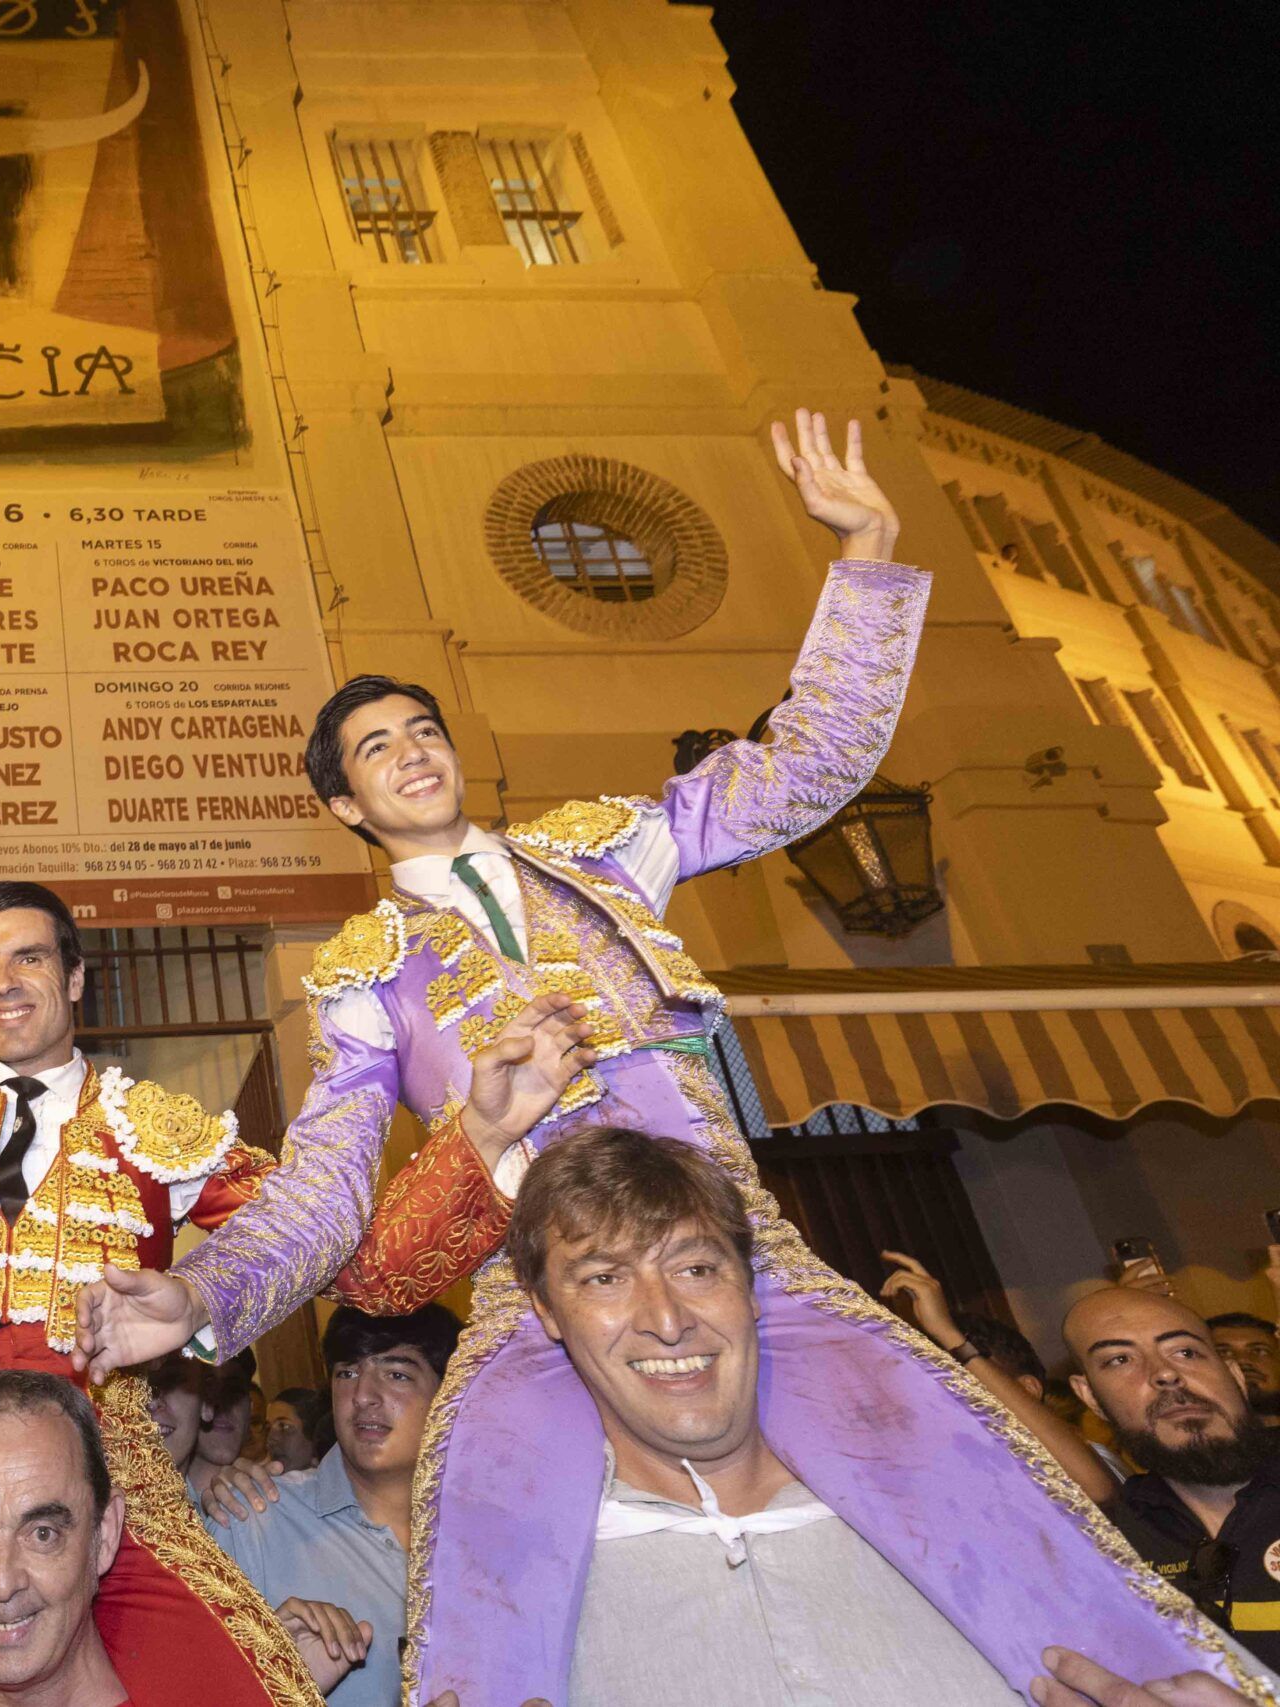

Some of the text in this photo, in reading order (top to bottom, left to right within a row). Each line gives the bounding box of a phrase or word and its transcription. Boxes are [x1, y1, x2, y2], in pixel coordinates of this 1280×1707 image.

[69, 507, 207, 525] 6,30 TARDE
[2, 542, 38, 550] CORRIDA
[81, 539, 162, 550] MARTES 15
[223, 541, 258, 549] CORRIDA
[93, 557, 253, 567] 6 TOROS de VICTORIANO DEL RÍO
[91, 571, 275, 597] PACO UREÑA
[93, 607, 280, 629] JUAN ORTEGA
[112, 640, 268, 663] ROCA REY
[14, 688, 48, 696] PRENSA
[94, 681, 199, 693] DOMINGO 20
[213, 683, 291, 691] CORRIDA REJONES
[125, 699, 278, 710] 6 TOROS de LOS ESPARTALES
[102, 714, 305, 741] ANDY CARTAGENA
[104, 752, 308, 781] DIEGO VENTURA
[107, 794, 320, 823] DUARTE FERNANDES
[22, 843, 59, 855] Abonos
[61, 842, 81, 854] 10%
[110, 841, 126, 852] del
[128, 841, 140, 852] 28
[143, 841, 156, 851] de
[158, 843, 187, 853] mayo
[189, 839, 199, 850] al
[202, 839, 207, 850] 7
[210, 839, 223, 850] de
[224, 839, 251, 851] junio
[37, 862, 80, 875] Taquilla:
[84, 860, 103, 872] 968
[106, 860, 117, 871] 23
[119, 860, 132, 871] 94
[135, 859, 147, 871] 05
[157, 859, 176, 870] 968
[178, 858, 190, 870] 20
[192, 858, 203, 869] 21
[205, 858, 217, 869] 42
[228, 856, 258, 868] Plaza:
[260, 857, 279, 868] 968
[281, 857, 292, 867] 23
[295, 856, 307, 867] 96
[309, 855, 321, 867] 59
